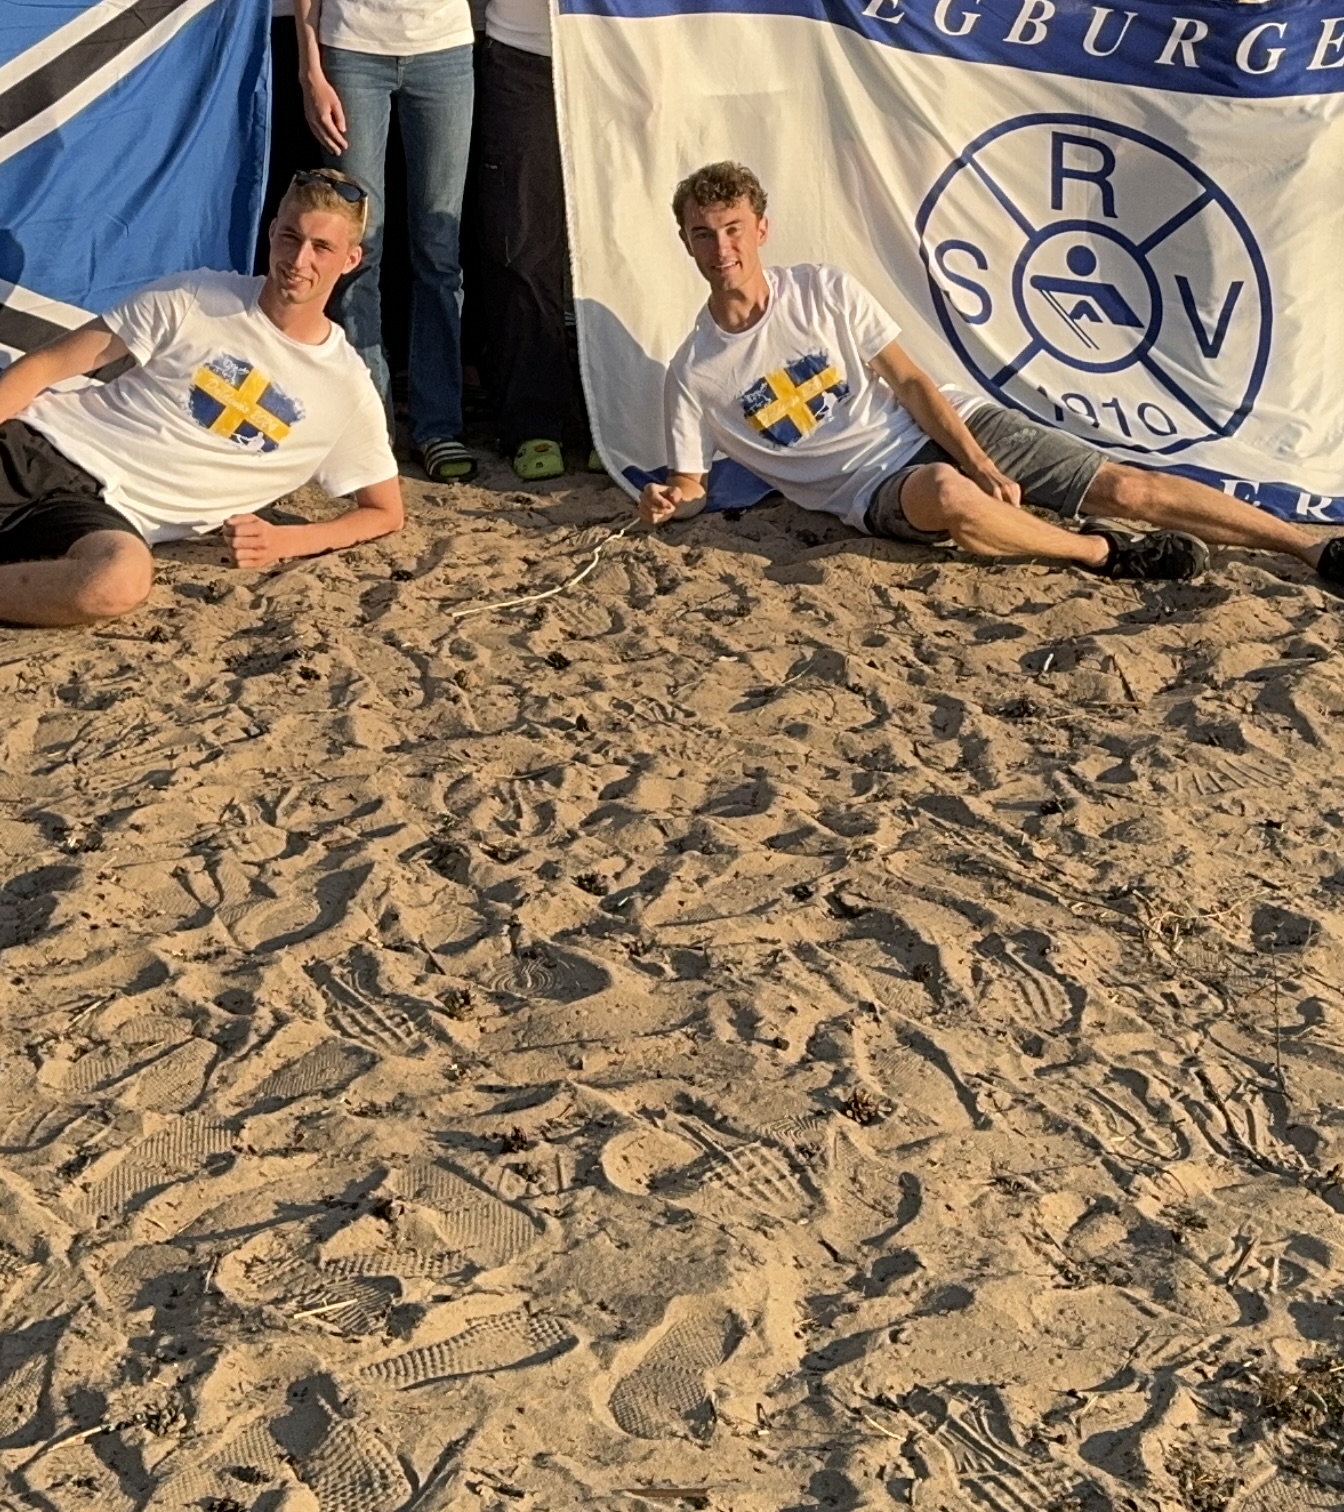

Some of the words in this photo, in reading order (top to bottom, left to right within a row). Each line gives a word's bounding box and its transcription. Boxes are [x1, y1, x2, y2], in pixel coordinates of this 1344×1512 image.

[1051, 130, 1119, 219] R
[934, 239, 993, 325] S
[1174, 274, 1244, 359] V
[1036, 384, 1178, 438] 1910
